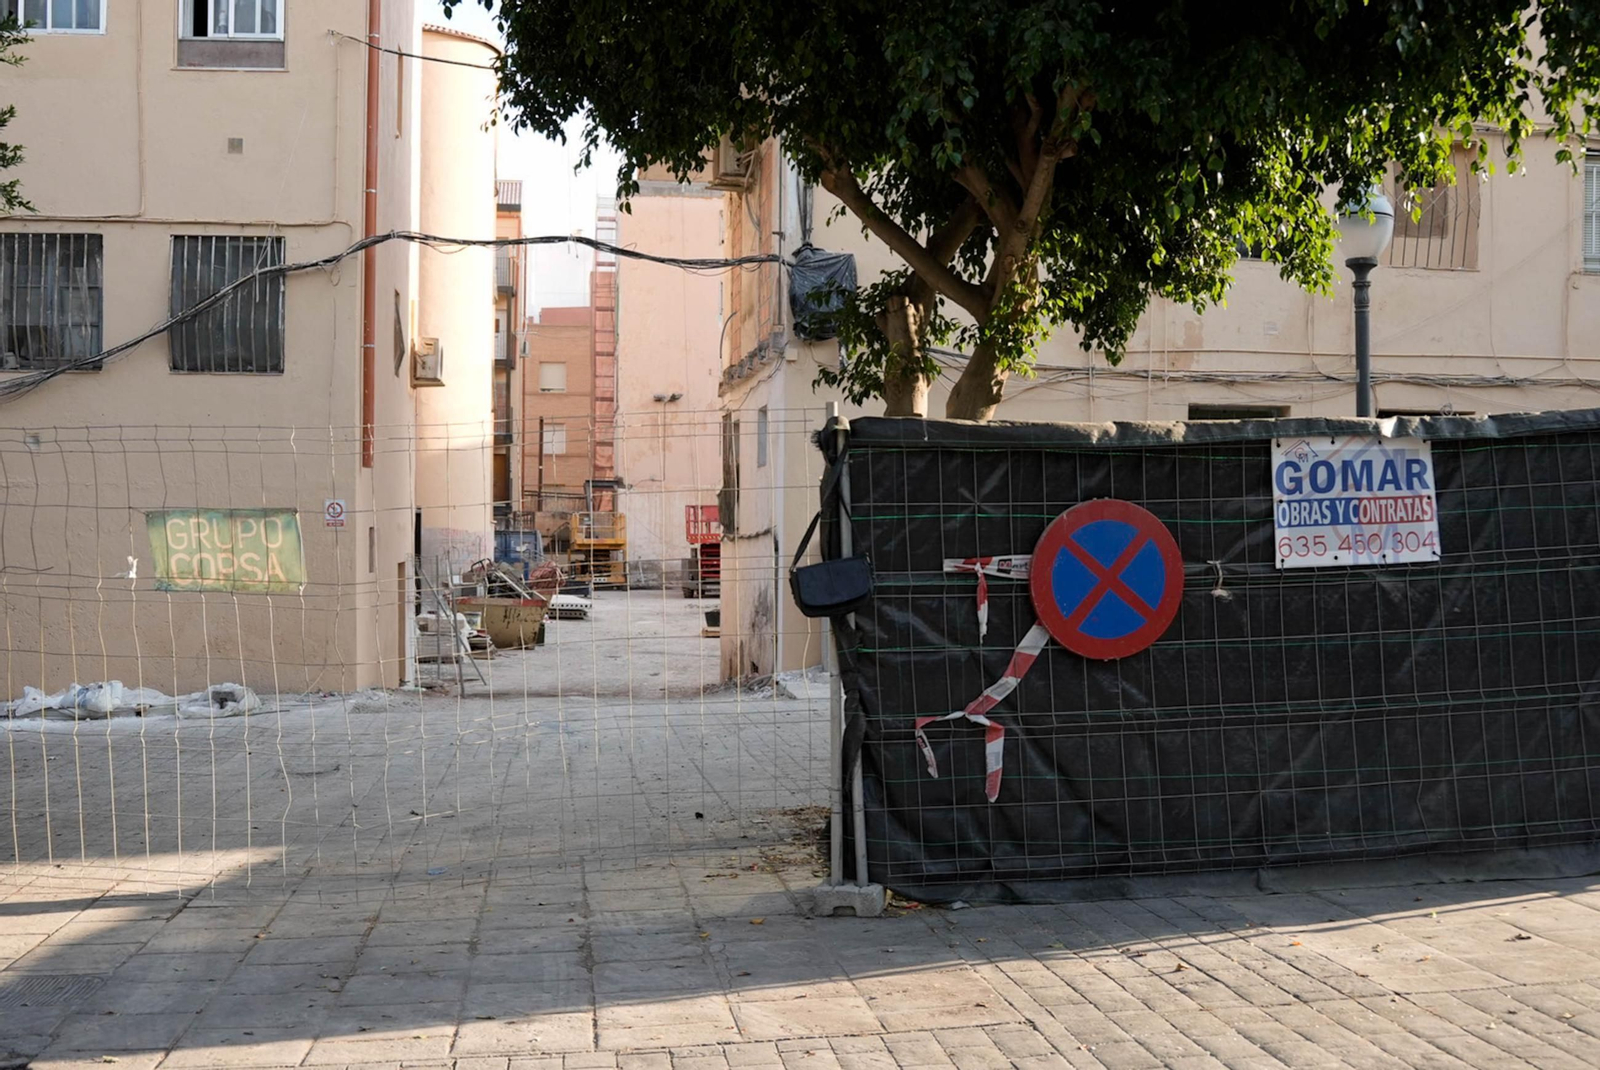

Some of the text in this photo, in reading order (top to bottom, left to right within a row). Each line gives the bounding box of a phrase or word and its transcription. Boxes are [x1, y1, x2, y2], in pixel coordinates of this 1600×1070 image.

[1275, 458, 1430, 496] GOMAR
[1278, 497, 1432, 527] OBRAS Y CONTRATAS
[166, 517, 283, 550] GRUPO
[1278, 531, 1436, 559] 635 450 304
[170, 552, 288, 585] COPSA
